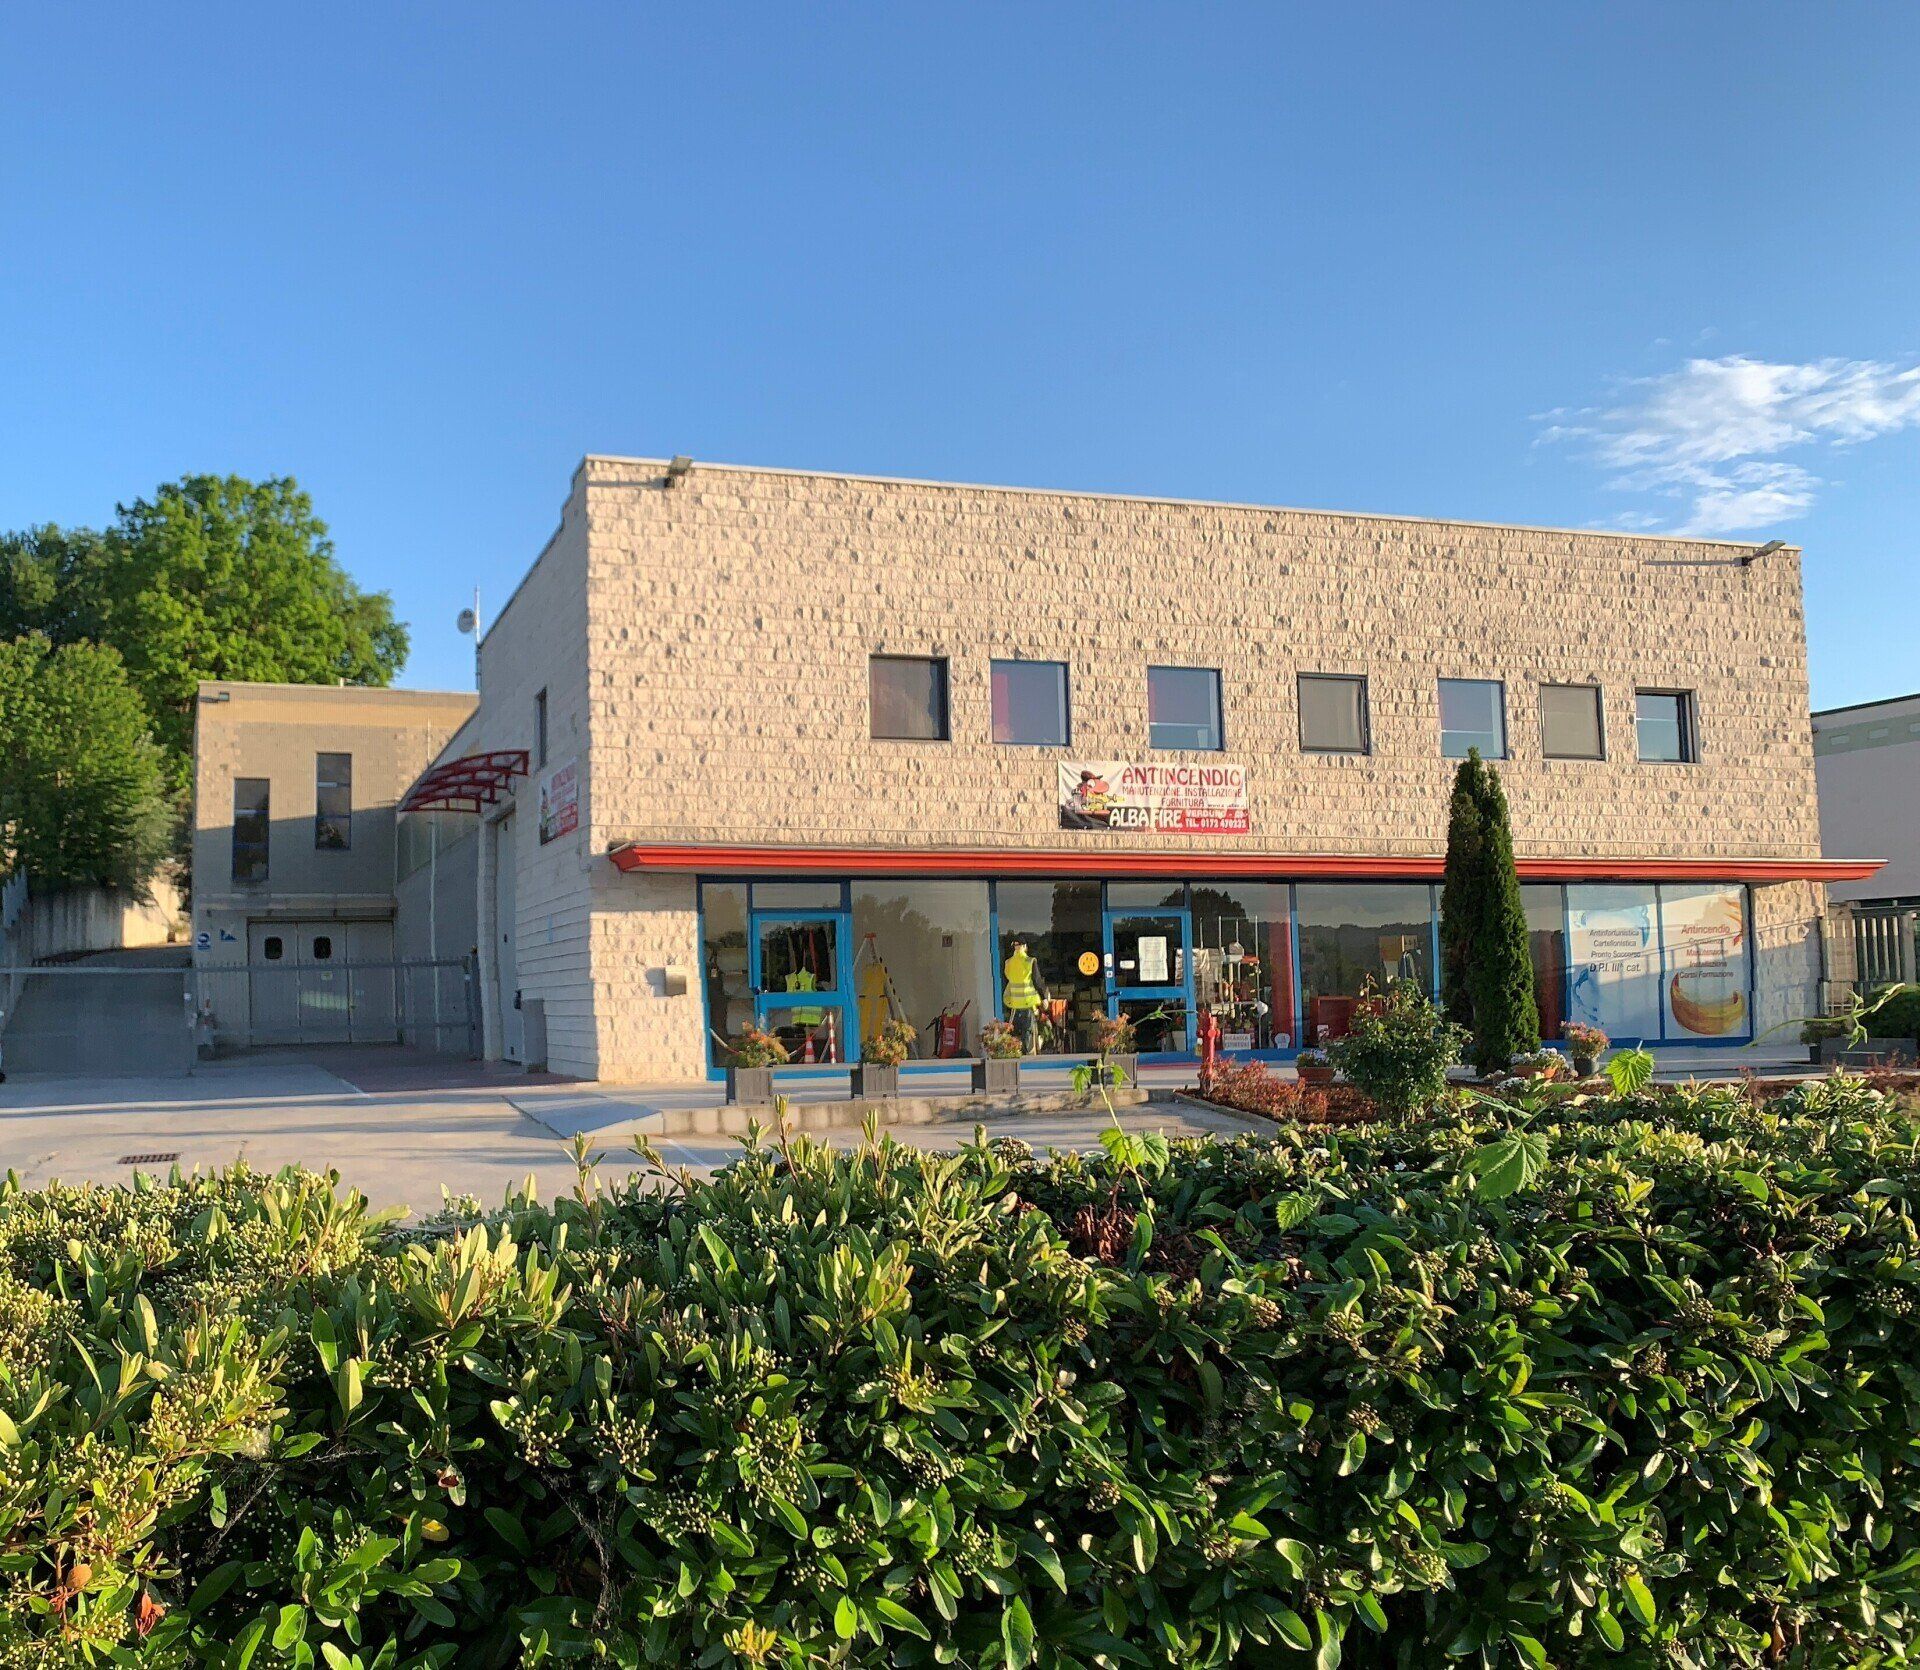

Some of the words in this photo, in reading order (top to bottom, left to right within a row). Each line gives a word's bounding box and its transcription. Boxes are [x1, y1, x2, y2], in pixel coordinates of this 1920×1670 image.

[1122, 767, 1241, 787] ANTINCENDIO
[1161, 797, 1205, 808] FORNITURA
[1109, 808, 1149, 827] ALBA
[1150, 808, 1182, 829] FIRE
[1681, 924, 1730, 935] Antincendio
